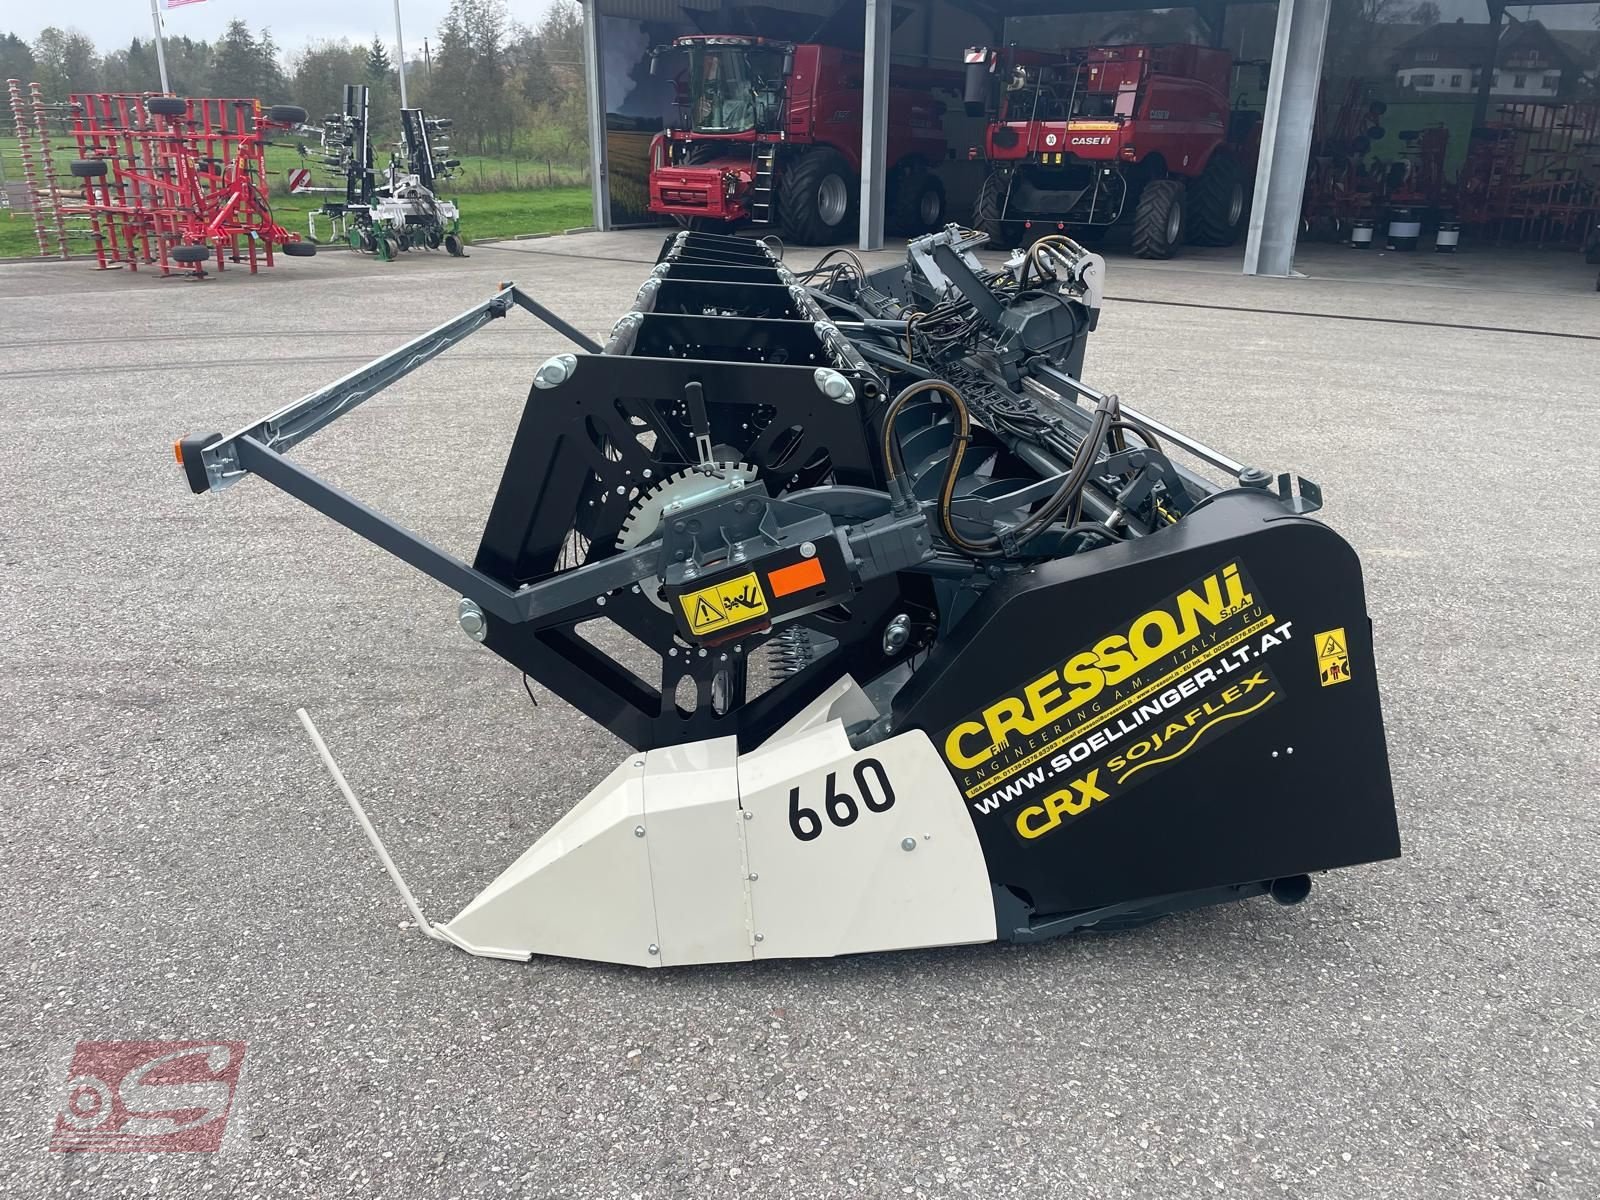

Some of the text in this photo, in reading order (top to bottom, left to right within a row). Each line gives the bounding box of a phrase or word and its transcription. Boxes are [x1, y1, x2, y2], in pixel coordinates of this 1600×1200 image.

[1071, 137, 1100, 145] CASE
[1220, 598, 1251, 619] S.p.A.
[964, 702, 1101, 786] ENGINEERING
[1115, 677, 1150, 700] A.M.
[1173, 632, 1217, 665] ITALY
[1243, 607, 1262, 624] EU
[971, 785, 983, 795] USA
[1061, 731, 1076, 743] email
[1137, 671, 1179, 699] www.cressoni.it
[974, 621, 1293, 815] WWW.SOELLINGER-LT.AT
[1016, 670, 1270, 839] CRX SOJAFLEX
[789, 758, 895, 841] 660
